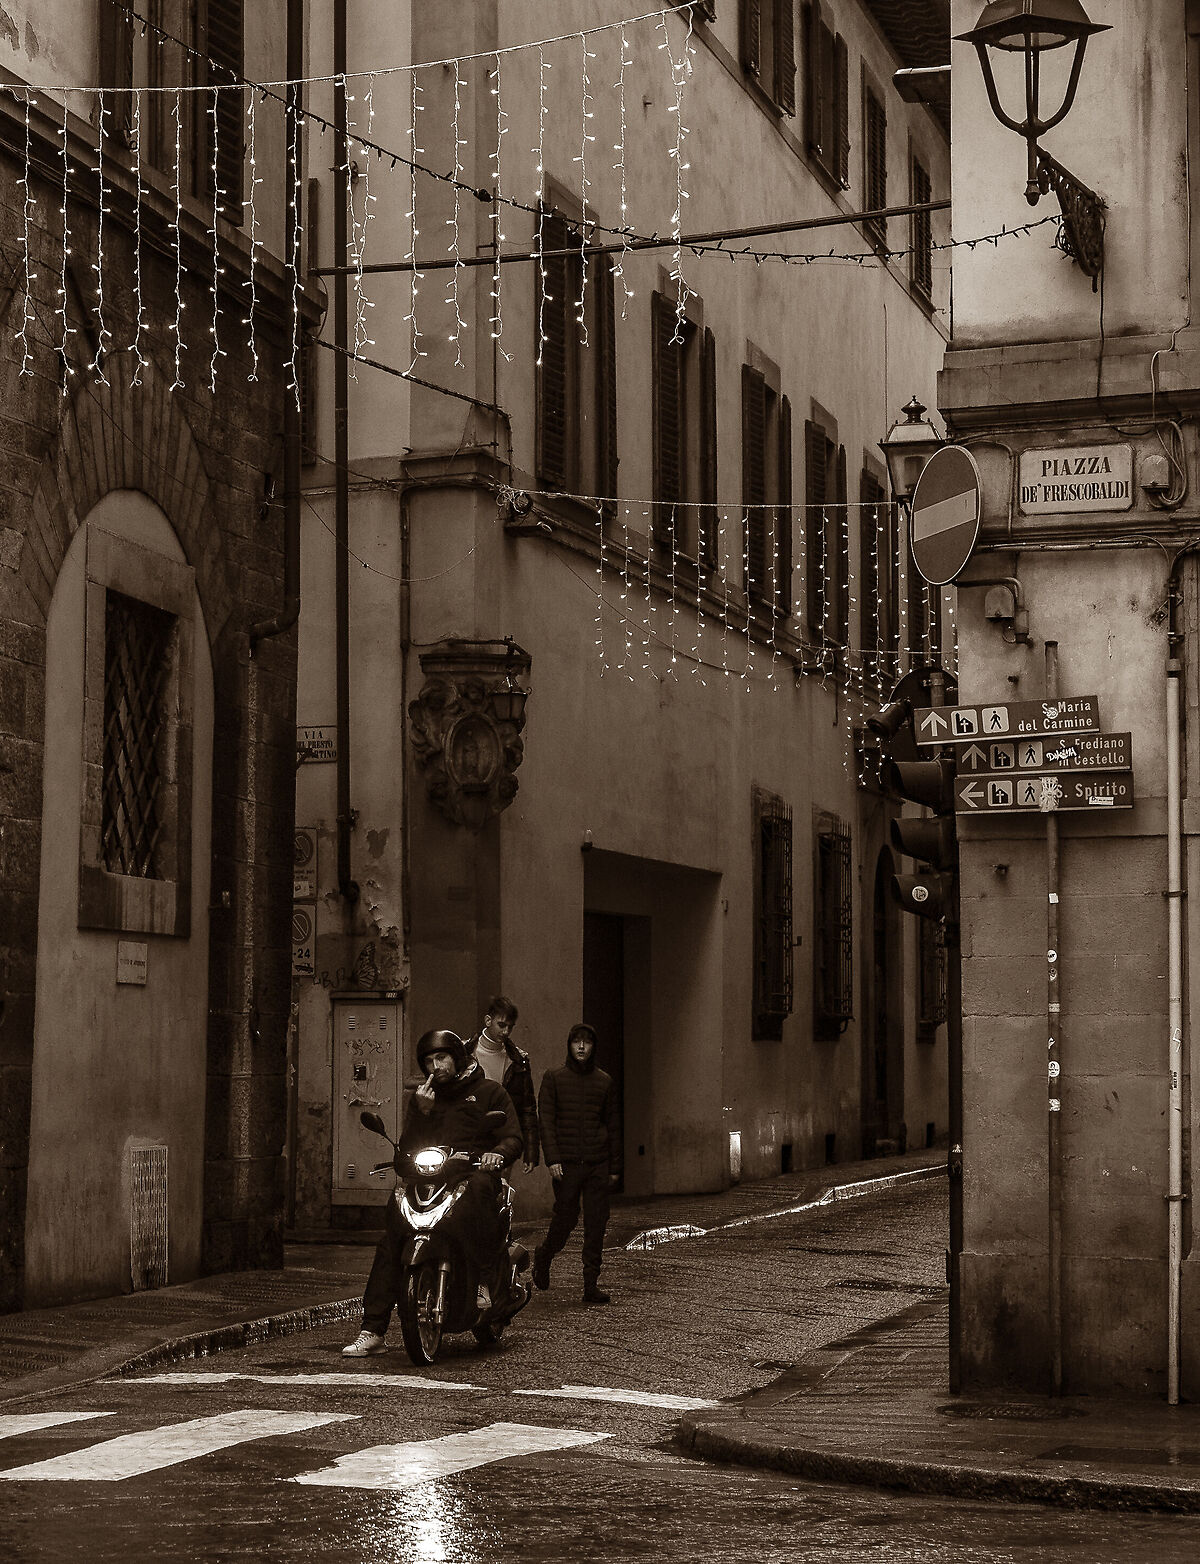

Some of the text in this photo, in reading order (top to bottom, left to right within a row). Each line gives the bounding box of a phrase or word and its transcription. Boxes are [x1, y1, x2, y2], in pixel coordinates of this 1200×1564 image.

[1041, 456, 1112, 478] PIAZZA
[1022, 481, 1131, 503] DE' FRESCOBALDI
[1058, 700, 1092, 713] Maria
[1018, 716, 1093, 732] del Carmine
[304, 731, 323, 739] VIA
[307, 741, 333, 749] PRESTO
[1074, 752, 1125, 766] Cestello
[1056, 784, 1069, 798] S.
[1075, 782, 1127, 801] Spirito
